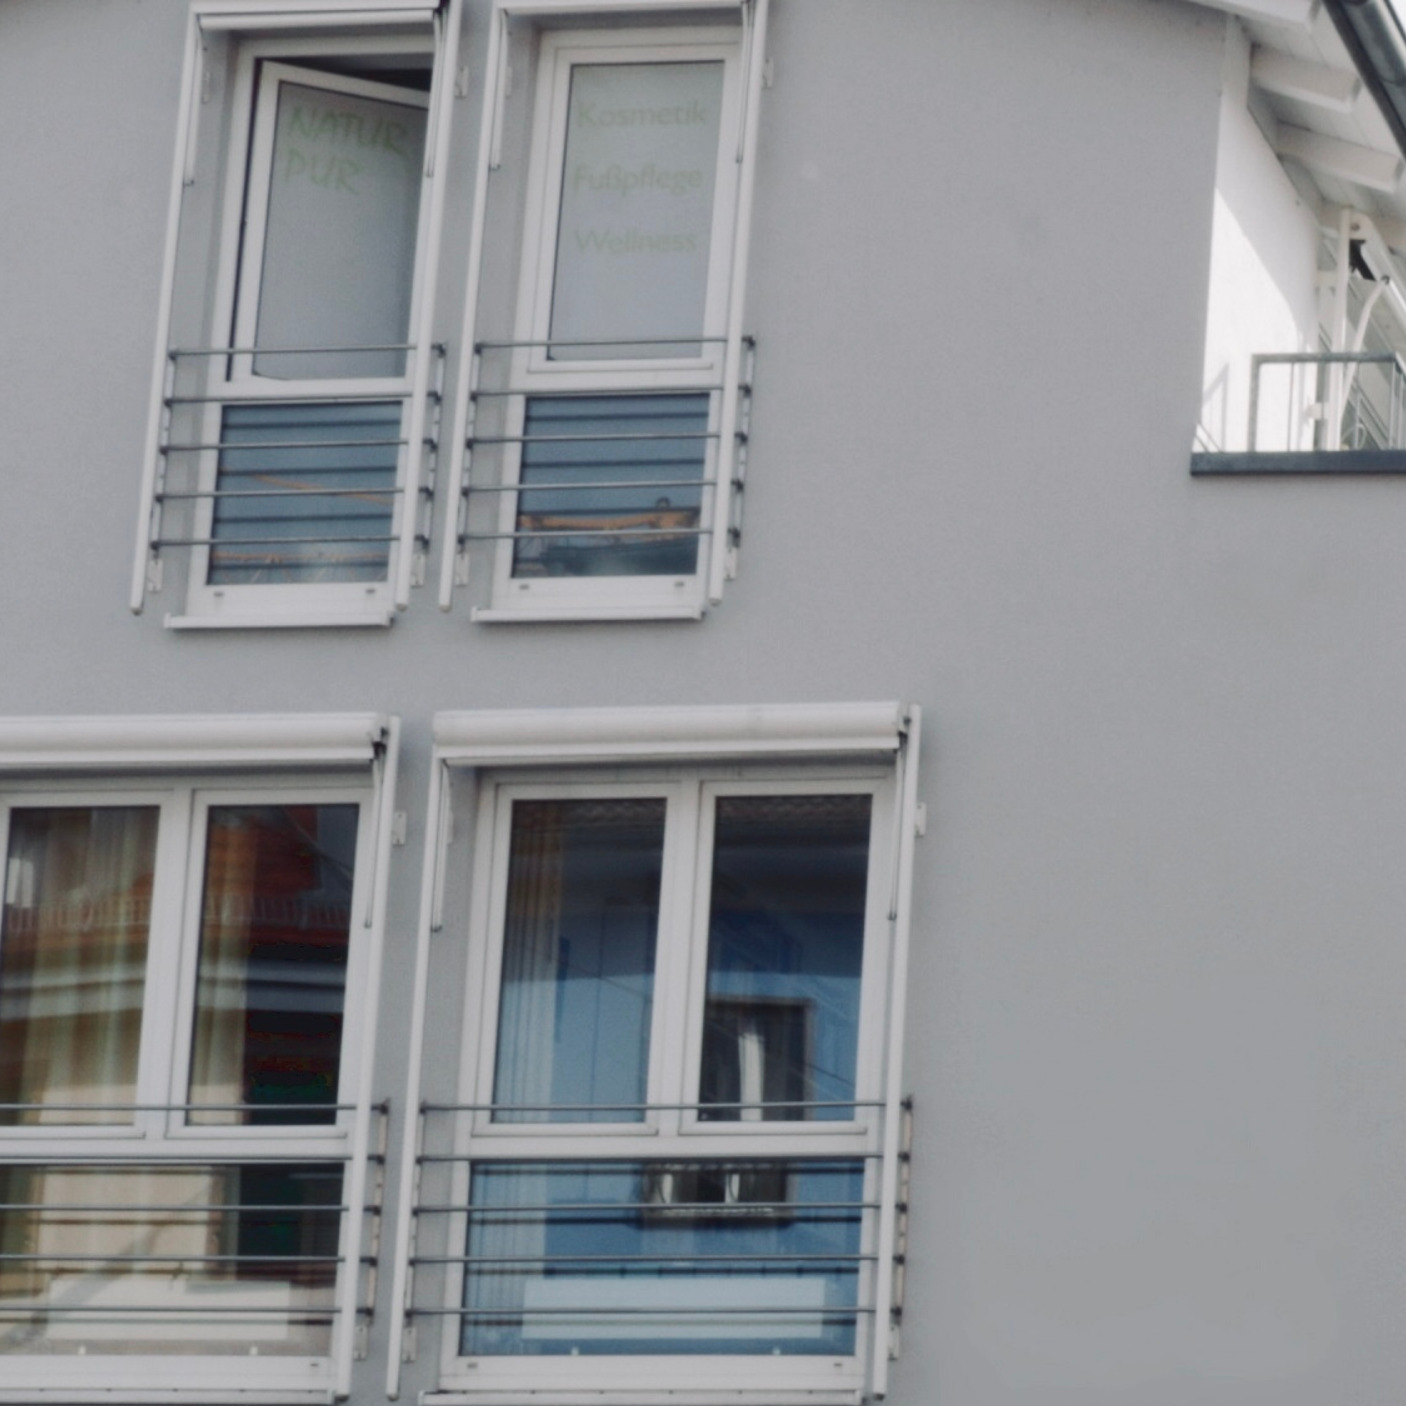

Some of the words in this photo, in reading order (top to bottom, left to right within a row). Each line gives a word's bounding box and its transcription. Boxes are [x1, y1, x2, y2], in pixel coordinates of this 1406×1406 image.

[576, 101, 707, 128] Kosmetik
[290, 107, 411, 162] NATUR
[284, 147, 364, 195] PUR
[573, 163, 703, 197] Fußpflege
[574, 228, 697, 253] Wellness
